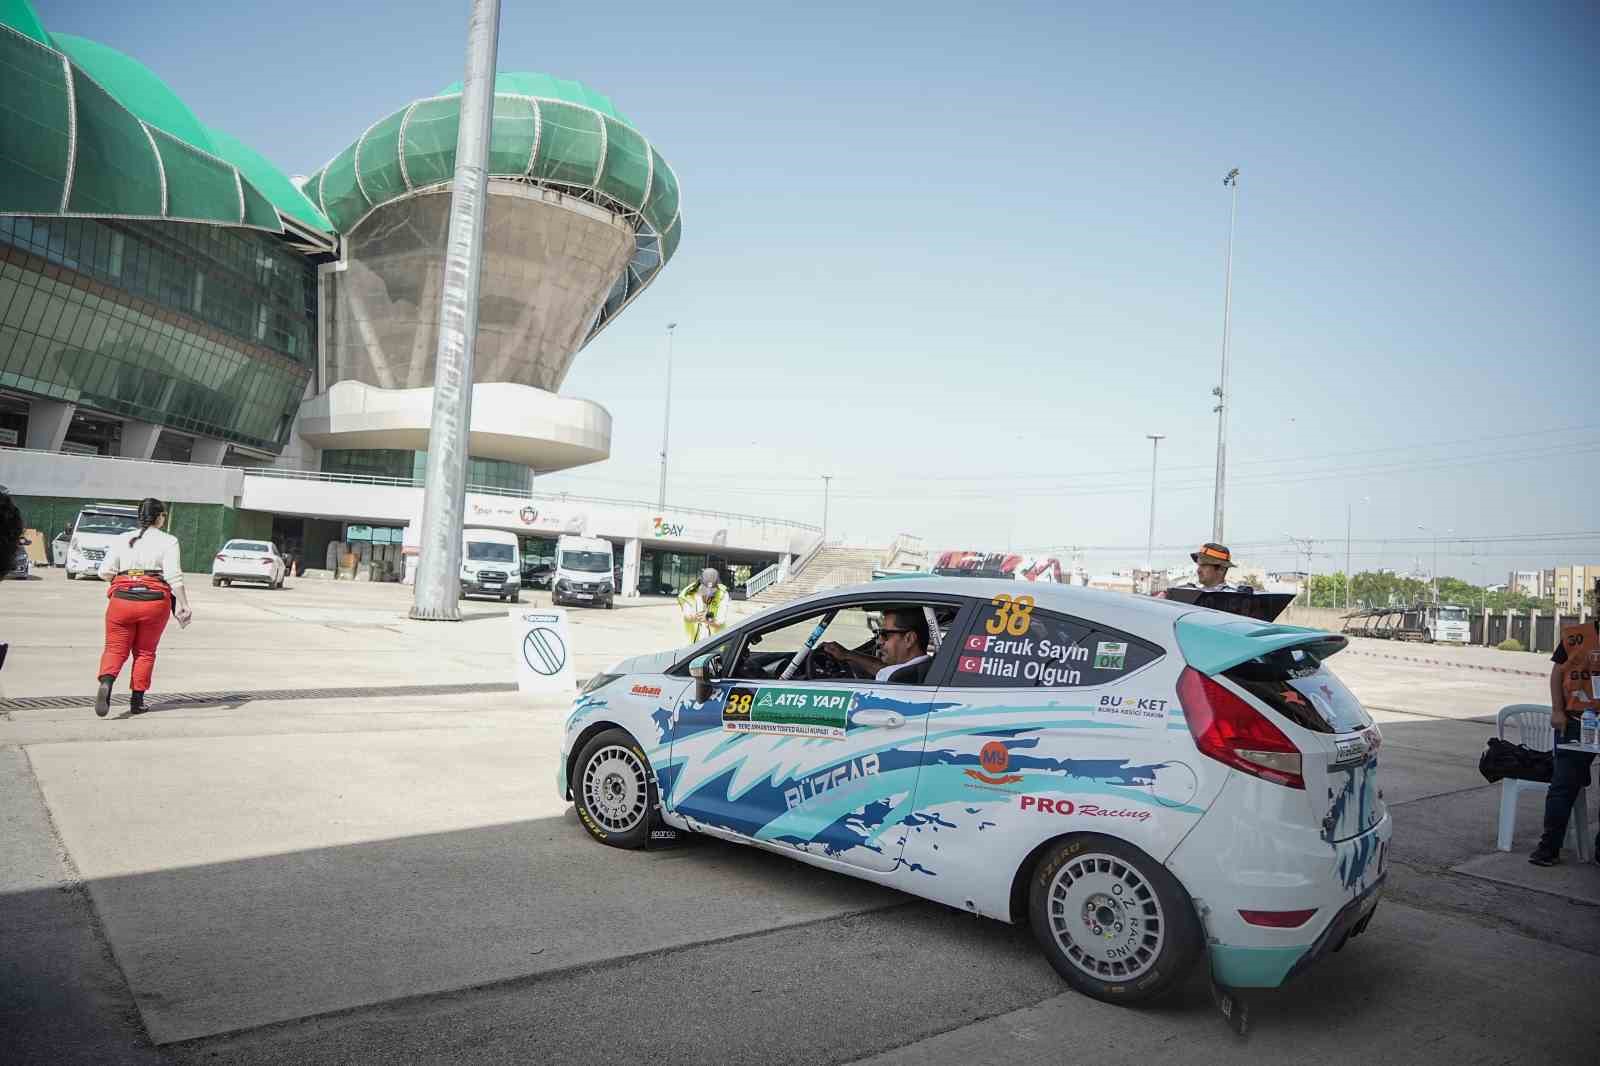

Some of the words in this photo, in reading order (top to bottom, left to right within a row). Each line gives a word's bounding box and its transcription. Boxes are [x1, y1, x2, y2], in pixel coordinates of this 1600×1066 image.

[985, 593, 1034, 636] 38
[983, 635, 1033, 657] Faruk
[978, 656, 1019, 679] Hilal
[1024, 660, 1081, 686] Olgun
[1100, 655, 1121, 668] OK
[725, 694, 752, 714] 38
[775, 693, 808, 708] ATIŞ
[812, 695, 845, 709] YAPI
[1020, 795, 1075, 816] PRO
[1078, 804, 1152, 822] Racing
